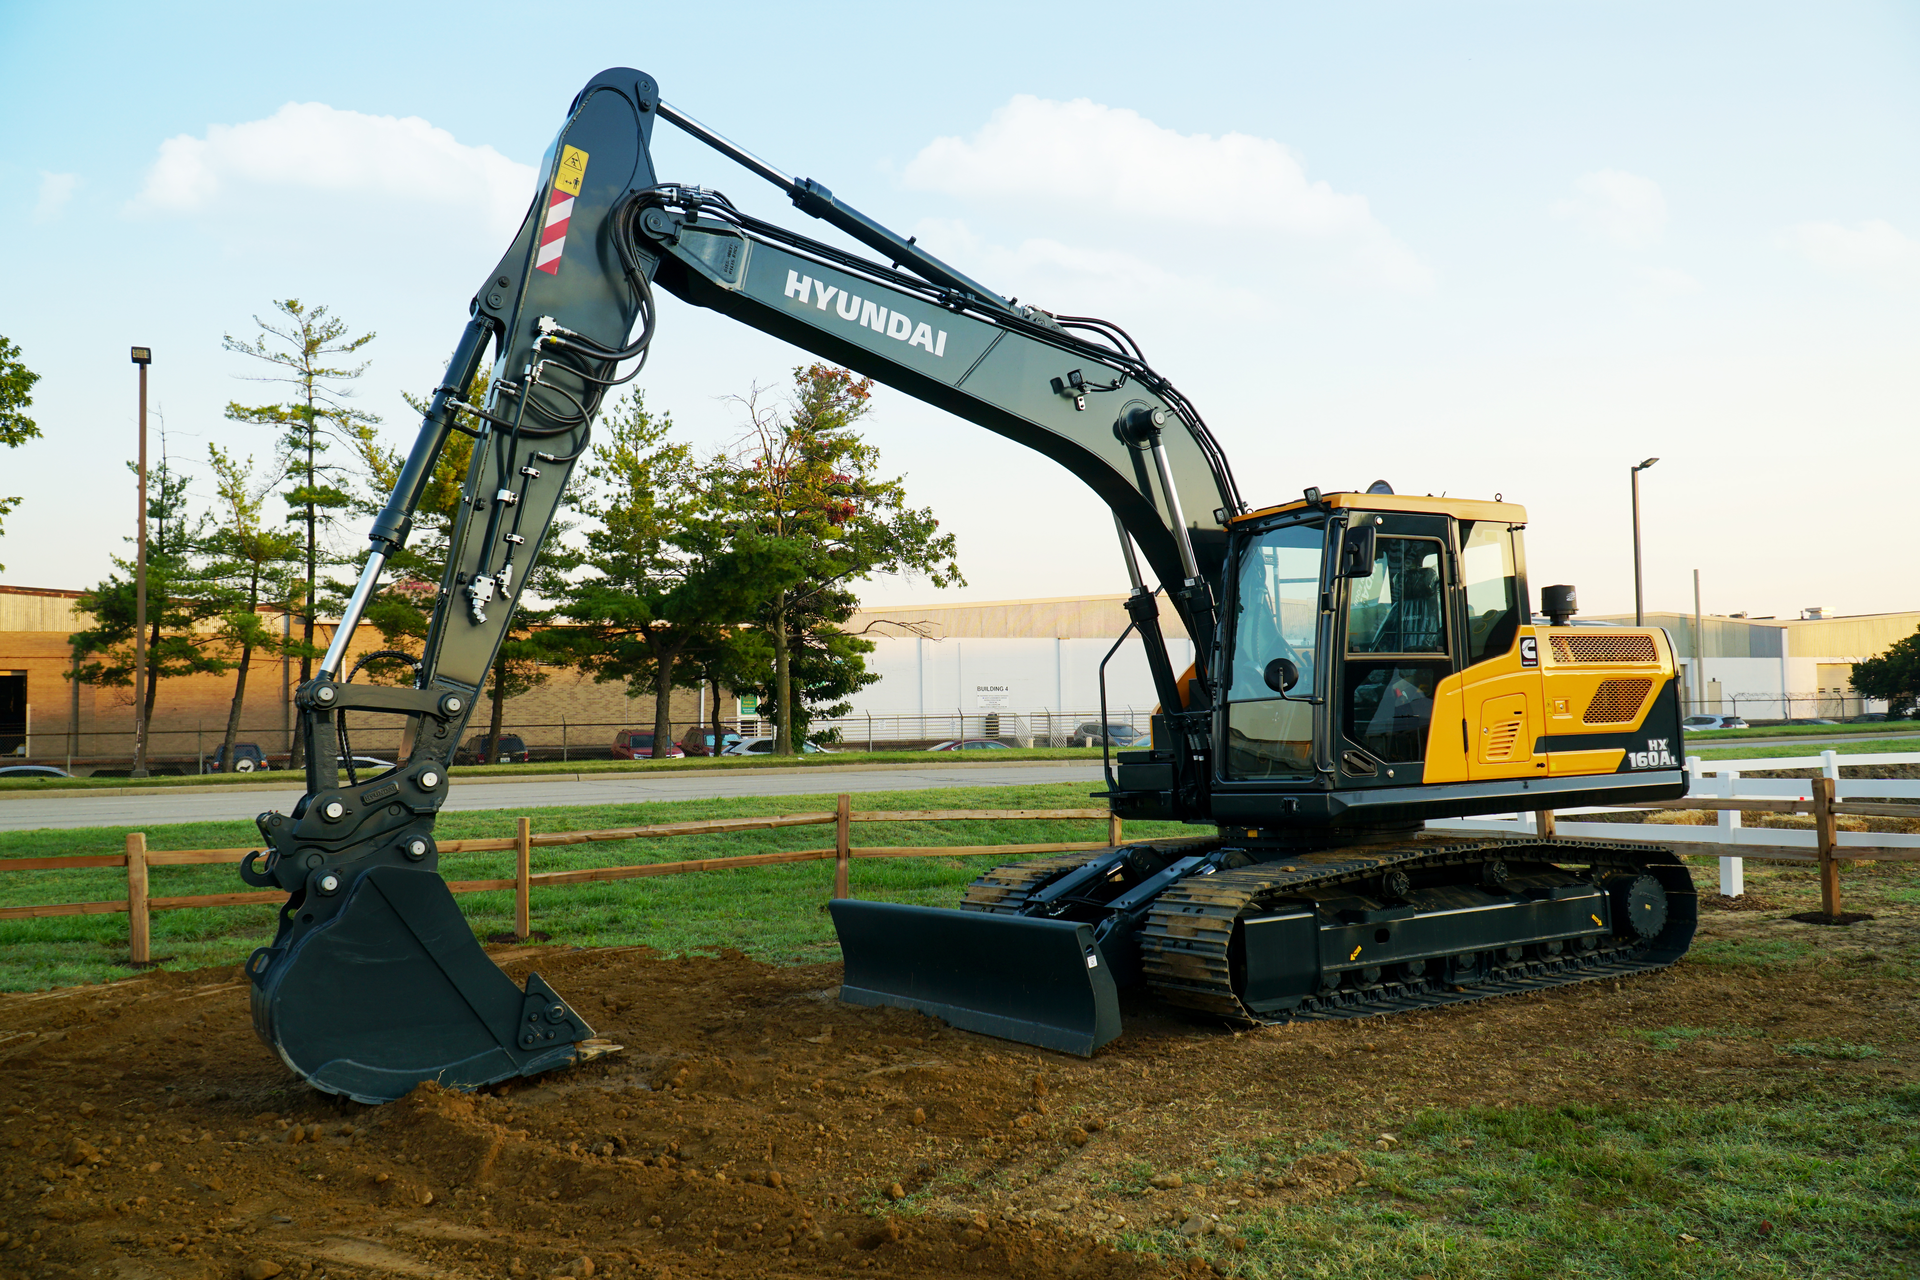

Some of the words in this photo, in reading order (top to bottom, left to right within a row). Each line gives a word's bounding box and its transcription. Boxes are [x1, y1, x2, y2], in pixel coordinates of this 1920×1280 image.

[784, 269, 947, 357] HYUNDAI
[1647, 739, 1668, 751] HX
[364, 785, 397, 801] HYUNDAI
